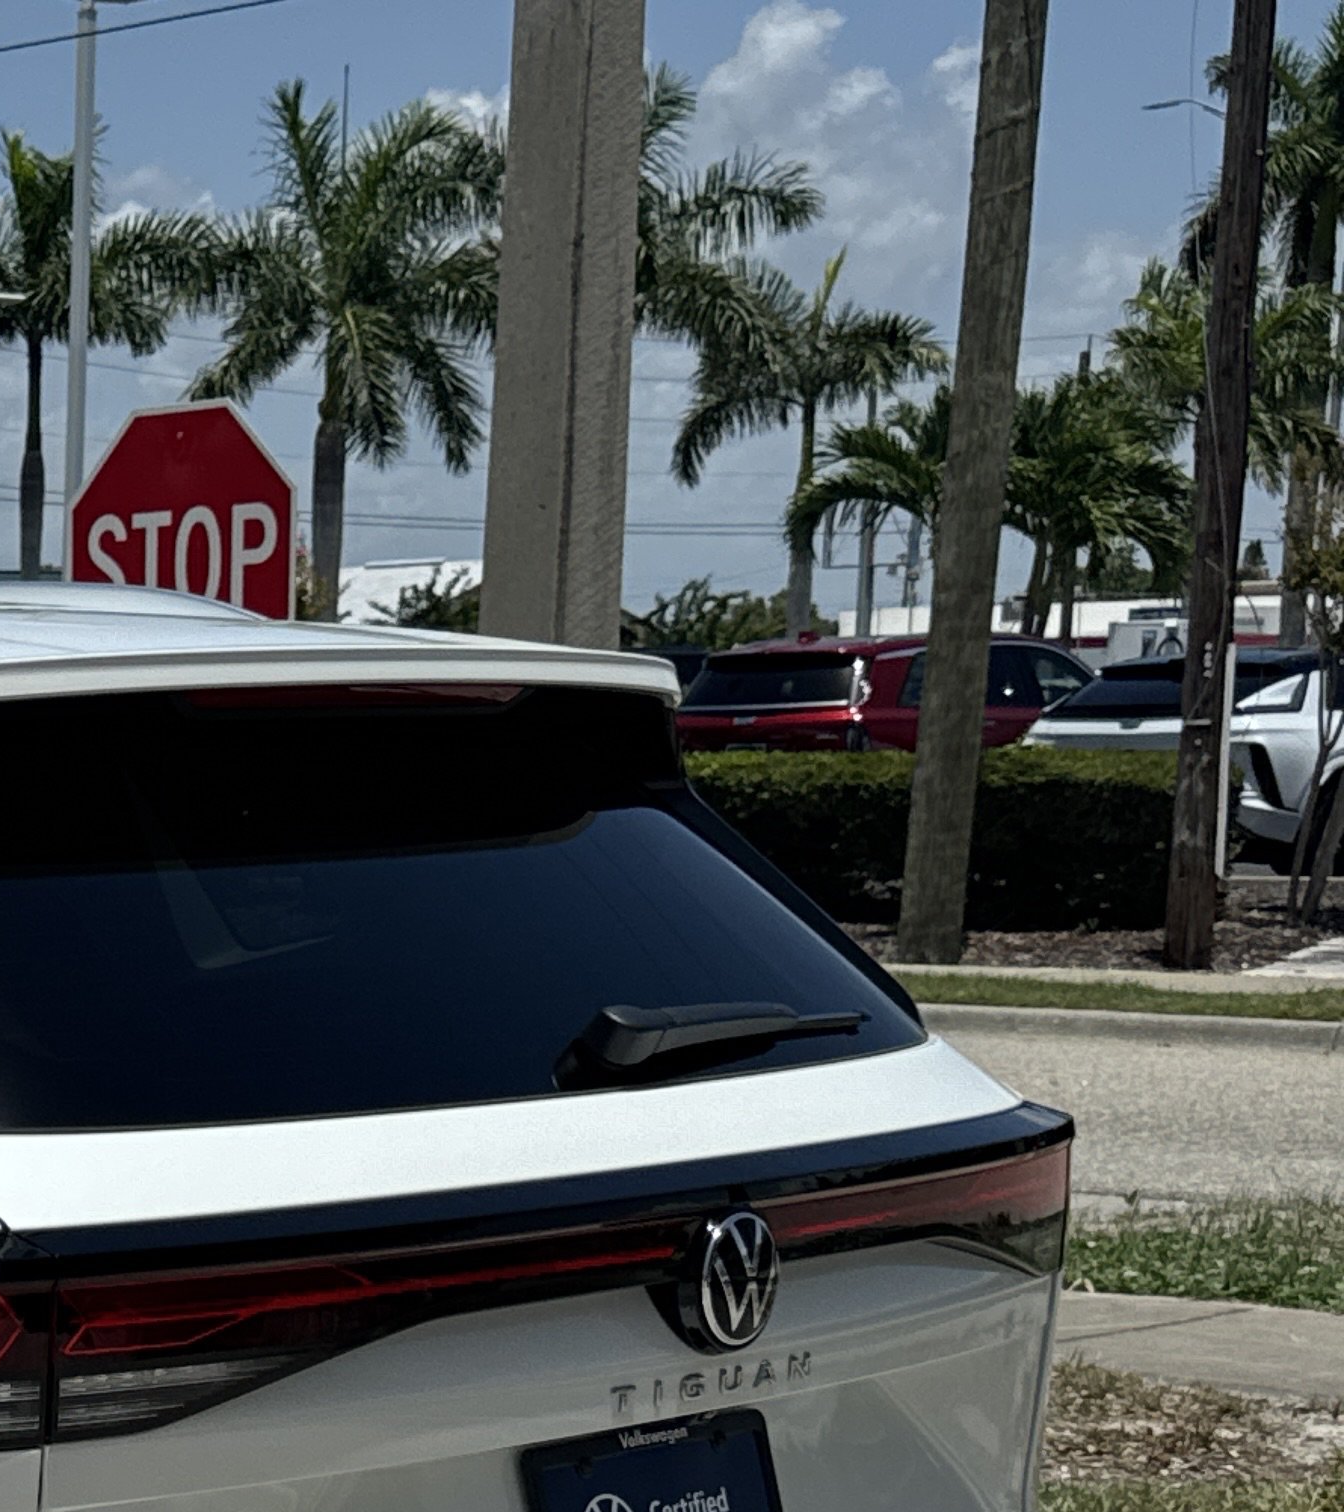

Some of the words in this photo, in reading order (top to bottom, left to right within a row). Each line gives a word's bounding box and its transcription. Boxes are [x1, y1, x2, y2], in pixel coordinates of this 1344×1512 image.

[87, 501, 279, 608] STOP
[610, 1350, 811, 1413] TIGUAN
[618, 1426, 688, 1450] Volkswagen
